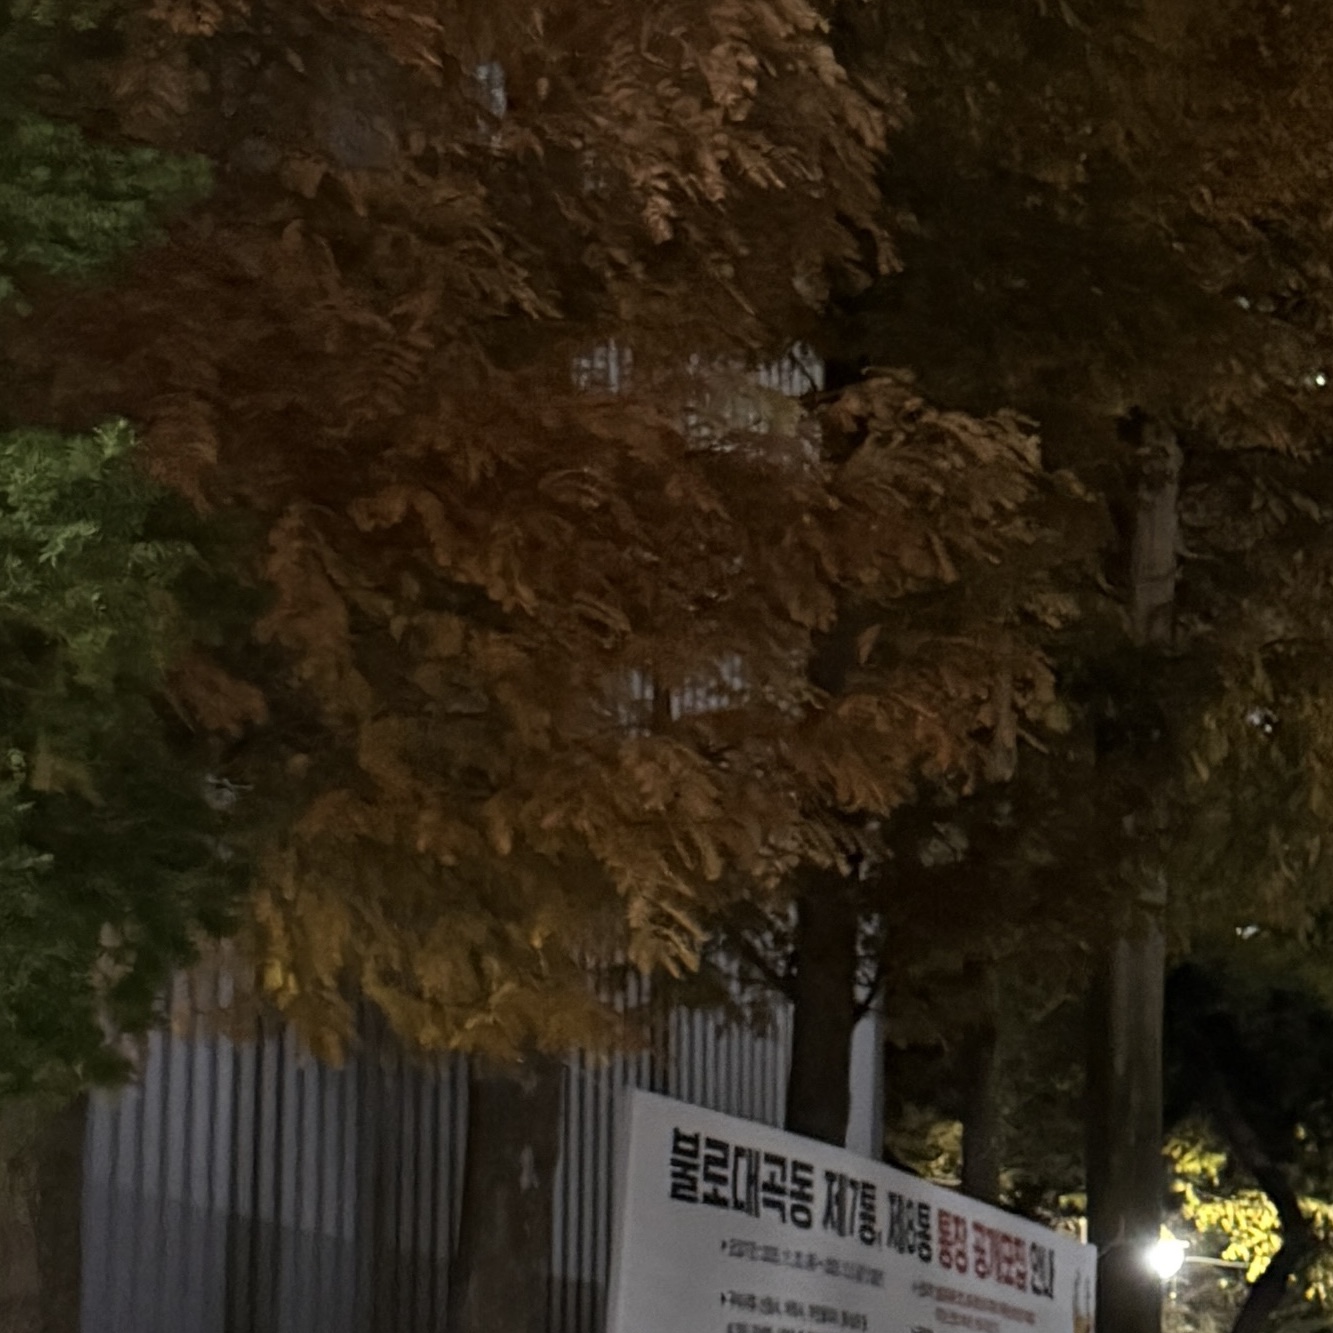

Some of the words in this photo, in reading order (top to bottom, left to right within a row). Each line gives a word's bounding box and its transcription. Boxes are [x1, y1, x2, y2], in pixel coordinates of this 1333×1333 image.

[669, 1126, 814, 1230] 불로대곡동
[938, 1207, 968, 1273] 통장
[1031, 1242, 1055, 1300] 안내
